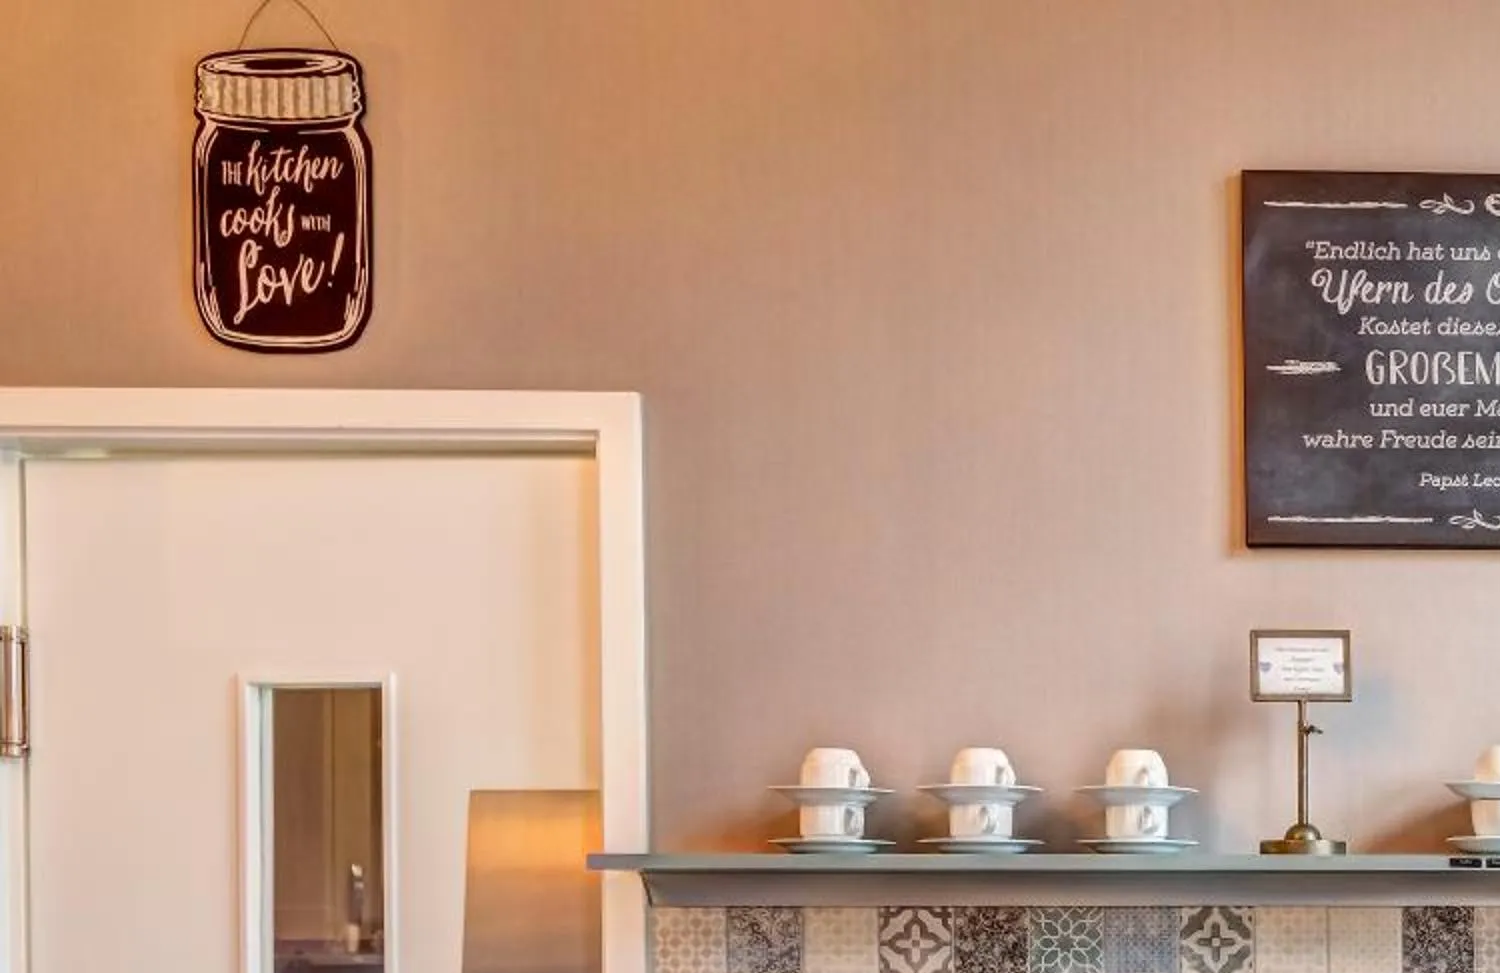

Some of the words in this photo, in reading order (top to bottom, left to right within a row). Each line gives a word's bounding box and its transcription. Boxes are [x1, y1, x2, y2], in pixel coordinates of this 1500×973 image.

[221, 161, 242, 185] THE
[246, 140, 344, 195] kitchen
[220, 186, 295, 247] cooks
[301, 215, 331, 231] WITH
[1407, 243, 1444, 261] hat
[1450, 244, 1491, 261] uns
[234, 232, 344, 324] Love!
[1311, 268, 1413, 314] Ufern
[1425, 270, 1473, 305] des
[1358, 316, 1432, 335] Kostet
[1370, 401, 1415, 418] und
[1419, 402, 1471, 418] euer
[1303, 431, 1373, 449] wahre
[1379, 431, 1458, 449] Freude
[1419, 472, 1469, 490] Papst
